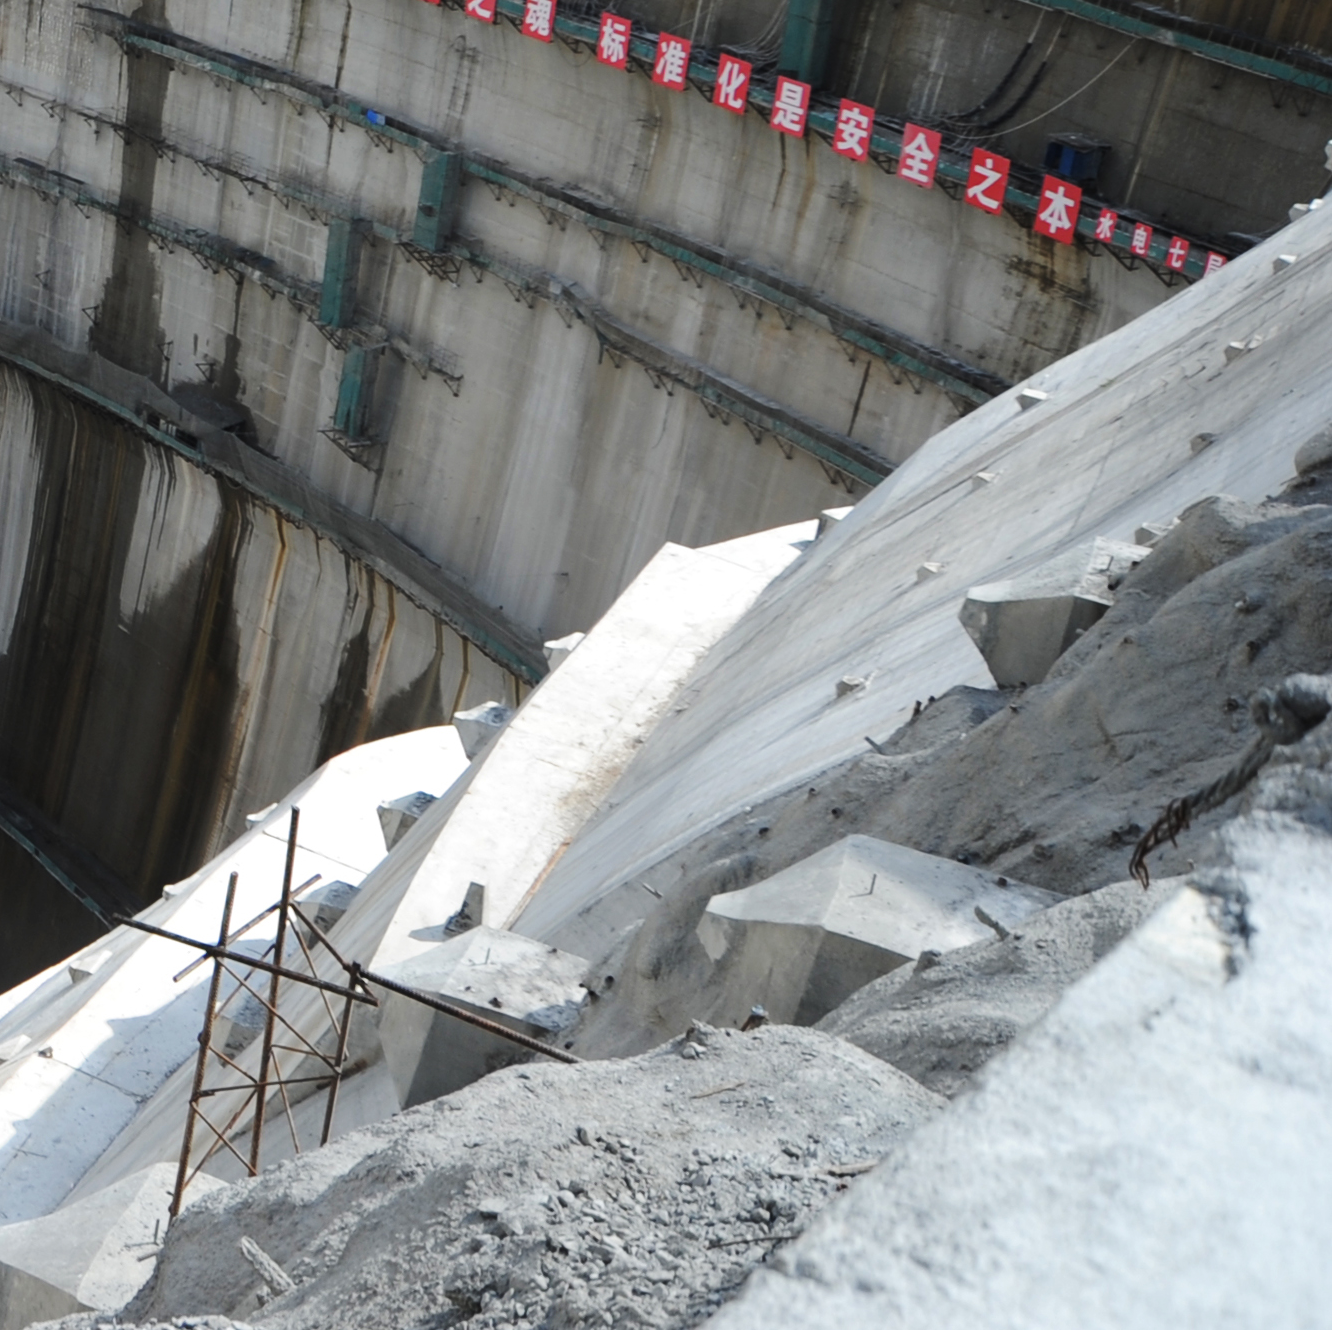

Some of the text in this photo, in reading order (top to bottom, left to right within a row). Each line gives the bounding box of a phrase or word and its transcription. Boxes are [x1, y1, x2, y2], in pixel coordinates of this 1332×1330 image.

[600, 17, 1076, 234] 标准化是安全之本
